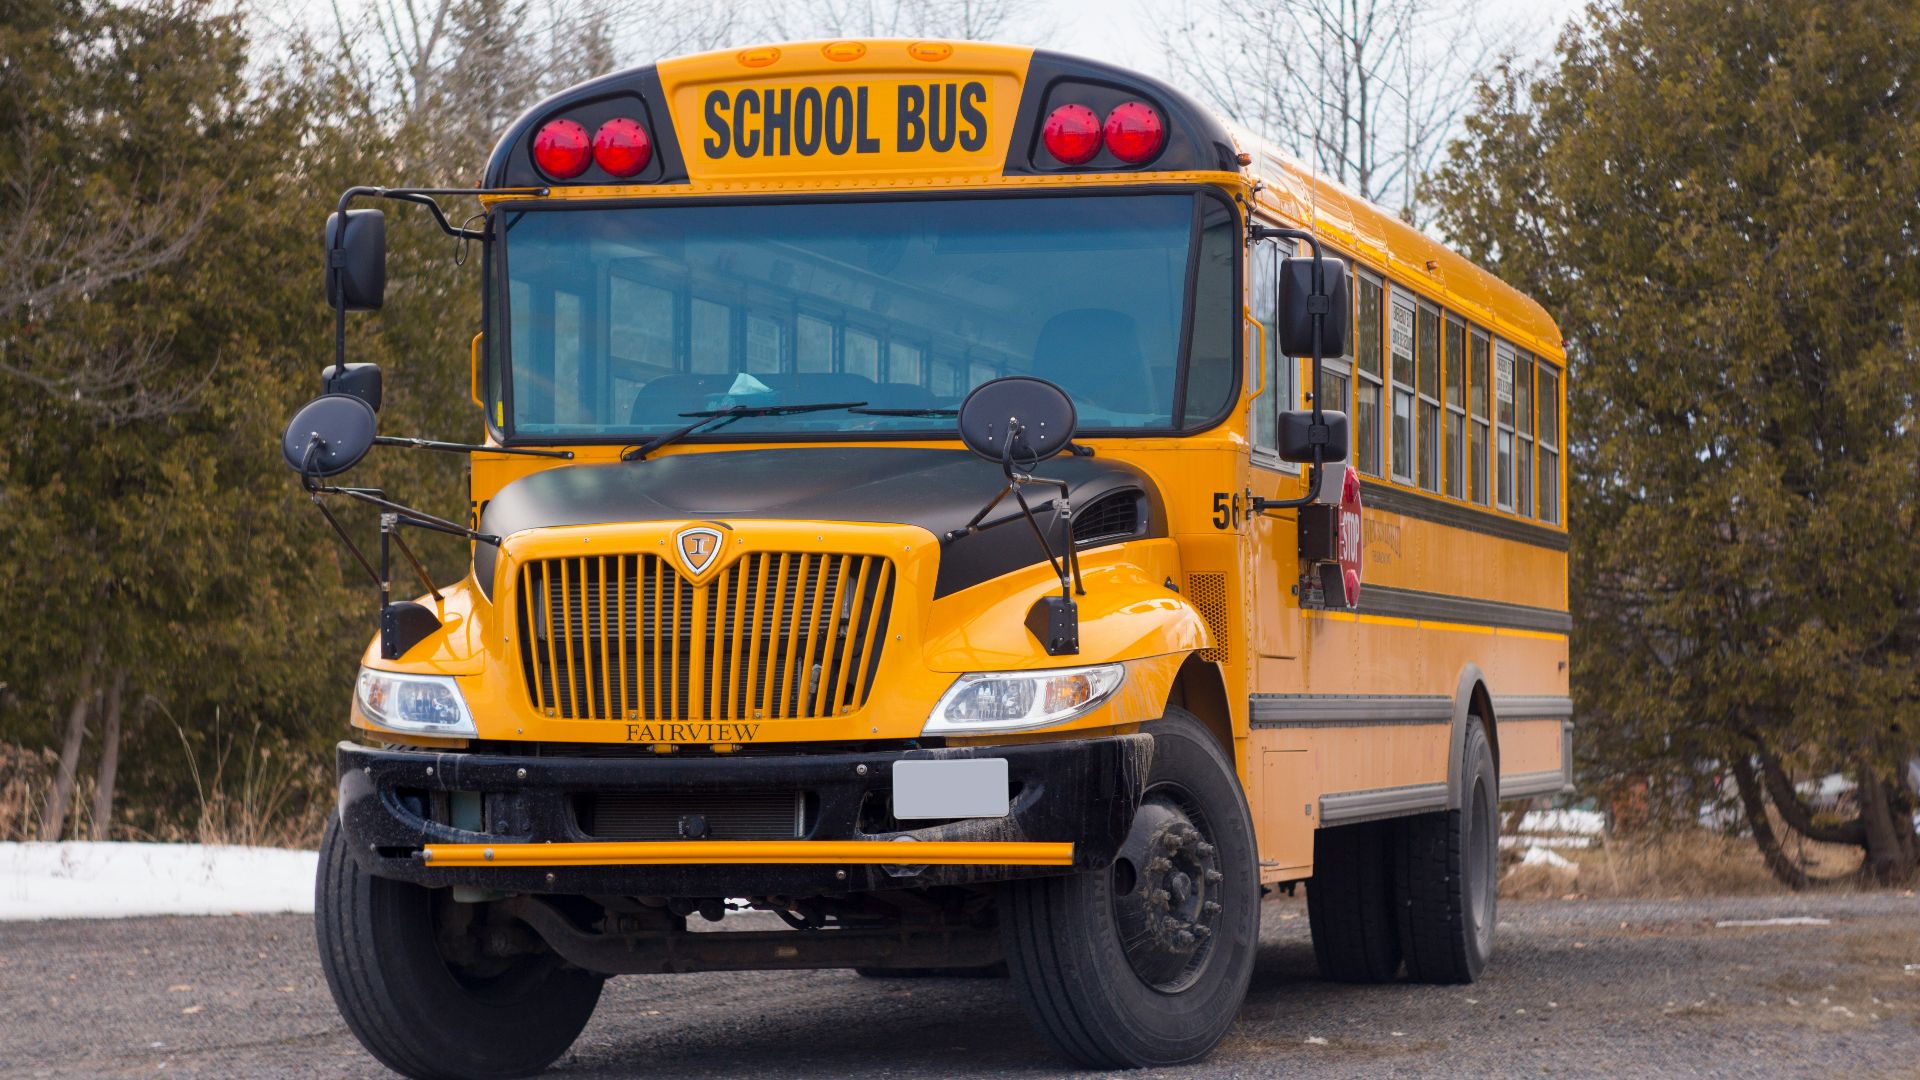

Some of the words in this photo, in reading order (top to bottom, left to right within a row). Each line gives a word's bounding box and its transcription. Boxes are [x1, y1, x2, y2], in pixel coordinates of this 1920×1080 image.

[703, 86, 880, 159] SCHOOL
[897, 81, 988, 153] BUS
[1342, 511, 1360, 563] STOP
[625, 723, 761, 741] FAIRVIEW
